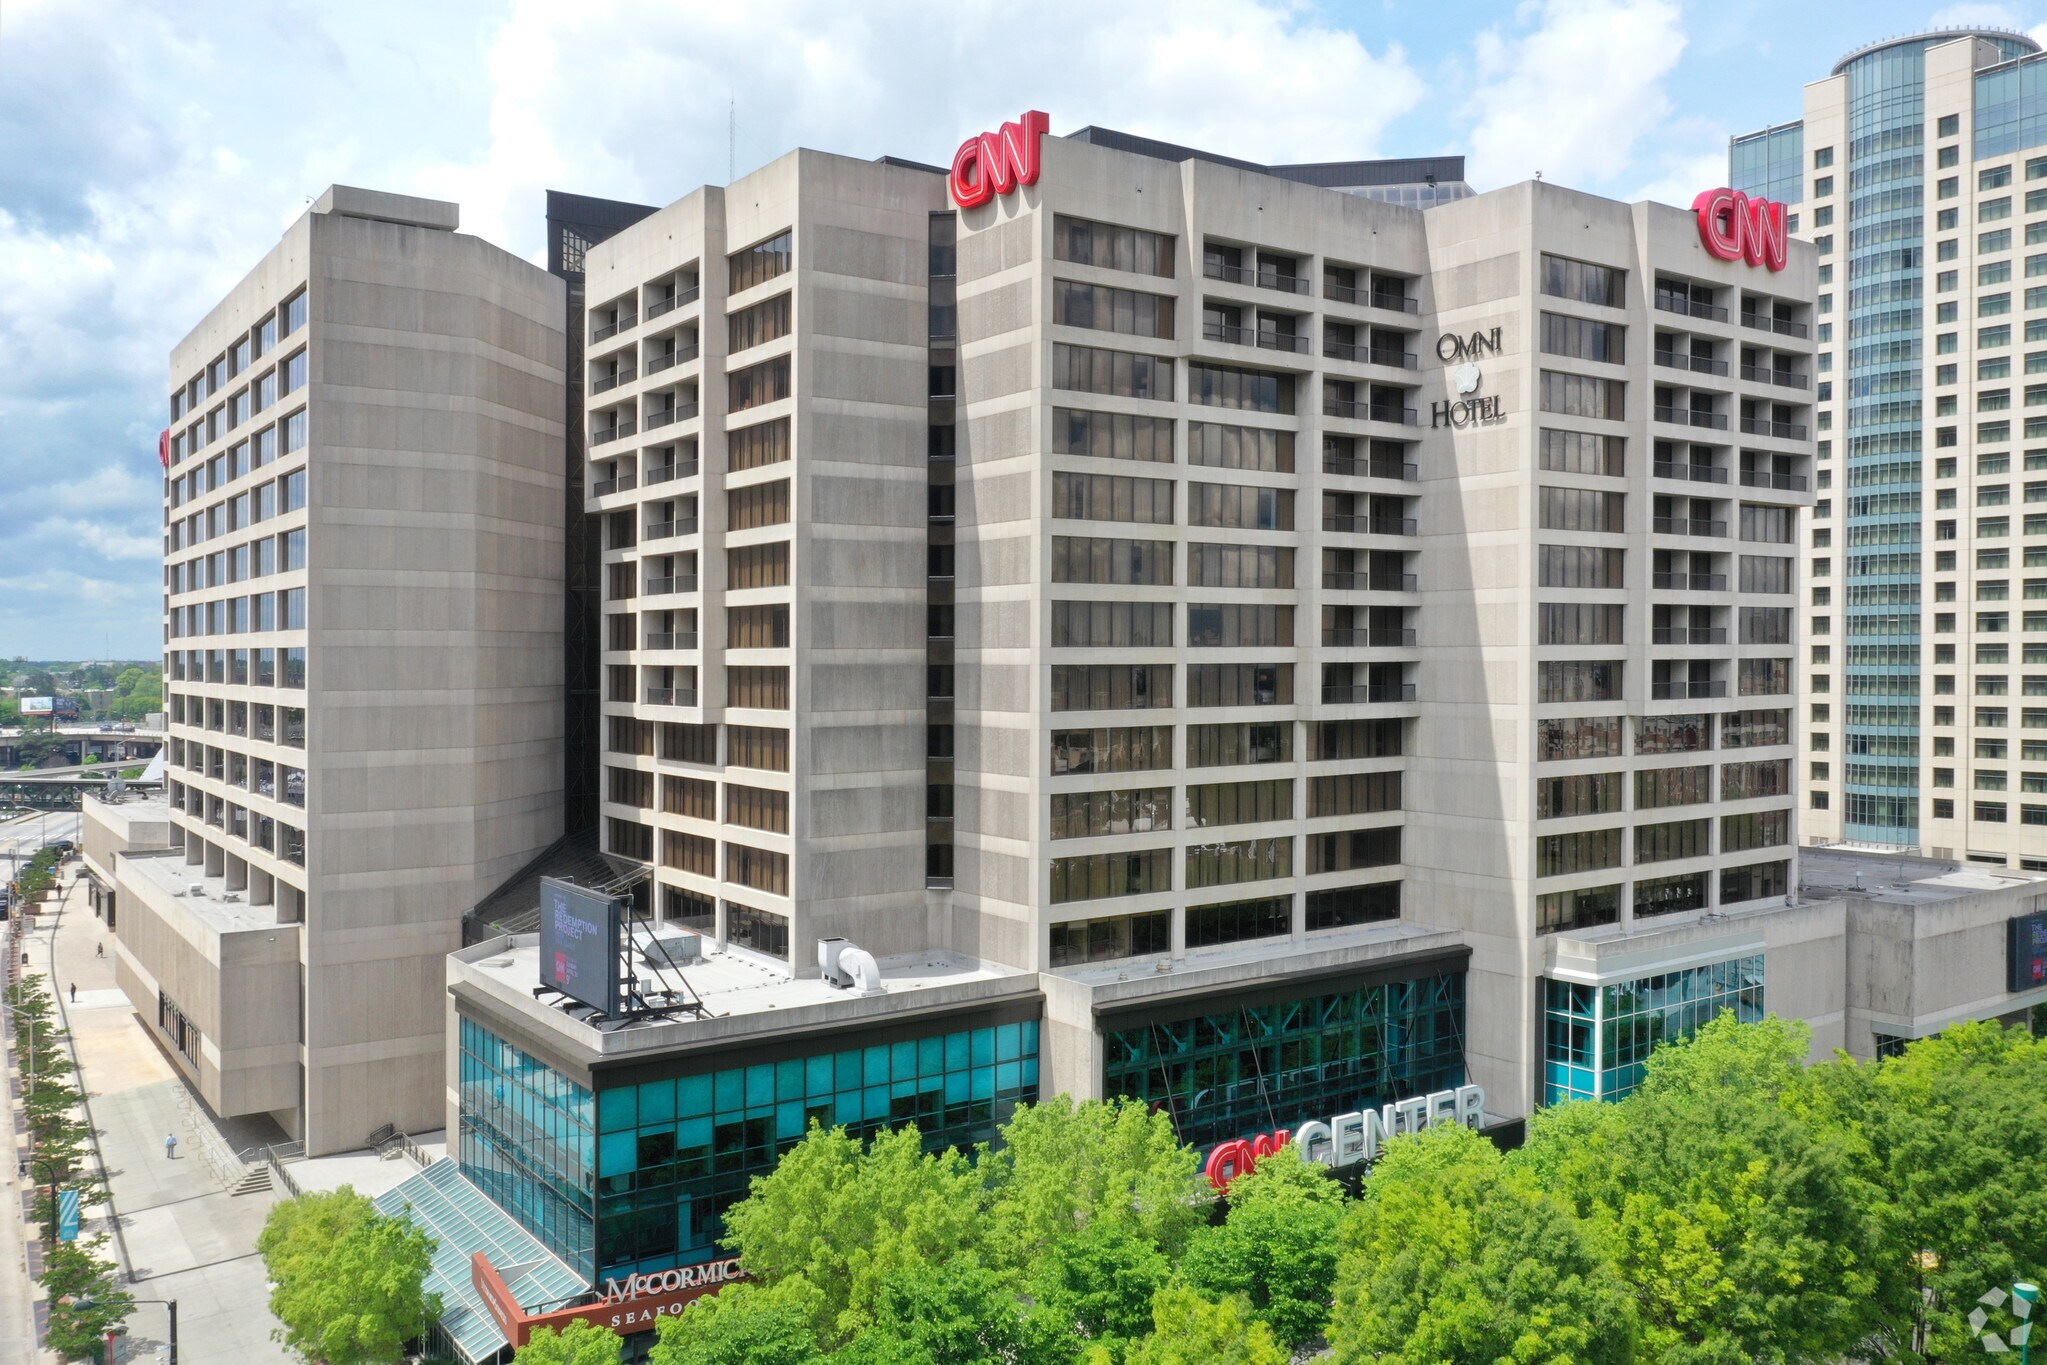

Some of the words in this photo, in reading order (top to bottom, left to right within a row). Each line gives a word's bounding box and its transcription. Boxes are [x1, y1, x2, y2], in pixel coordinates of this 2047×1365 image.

[951, 110, 1049, 209] CNN
[1692, 187, 1788, 272] CNN
[1437, 327, 1501, 361] OMNI
[1431, 395, 1506, 429] HOTEL
[554, 900, 567, 914] THE
[554, 909, 598, 936] REDEMPTION
[554, 920, 583, 941] PROJECT
[1296, 1084, 1486, 1168] CENTER
